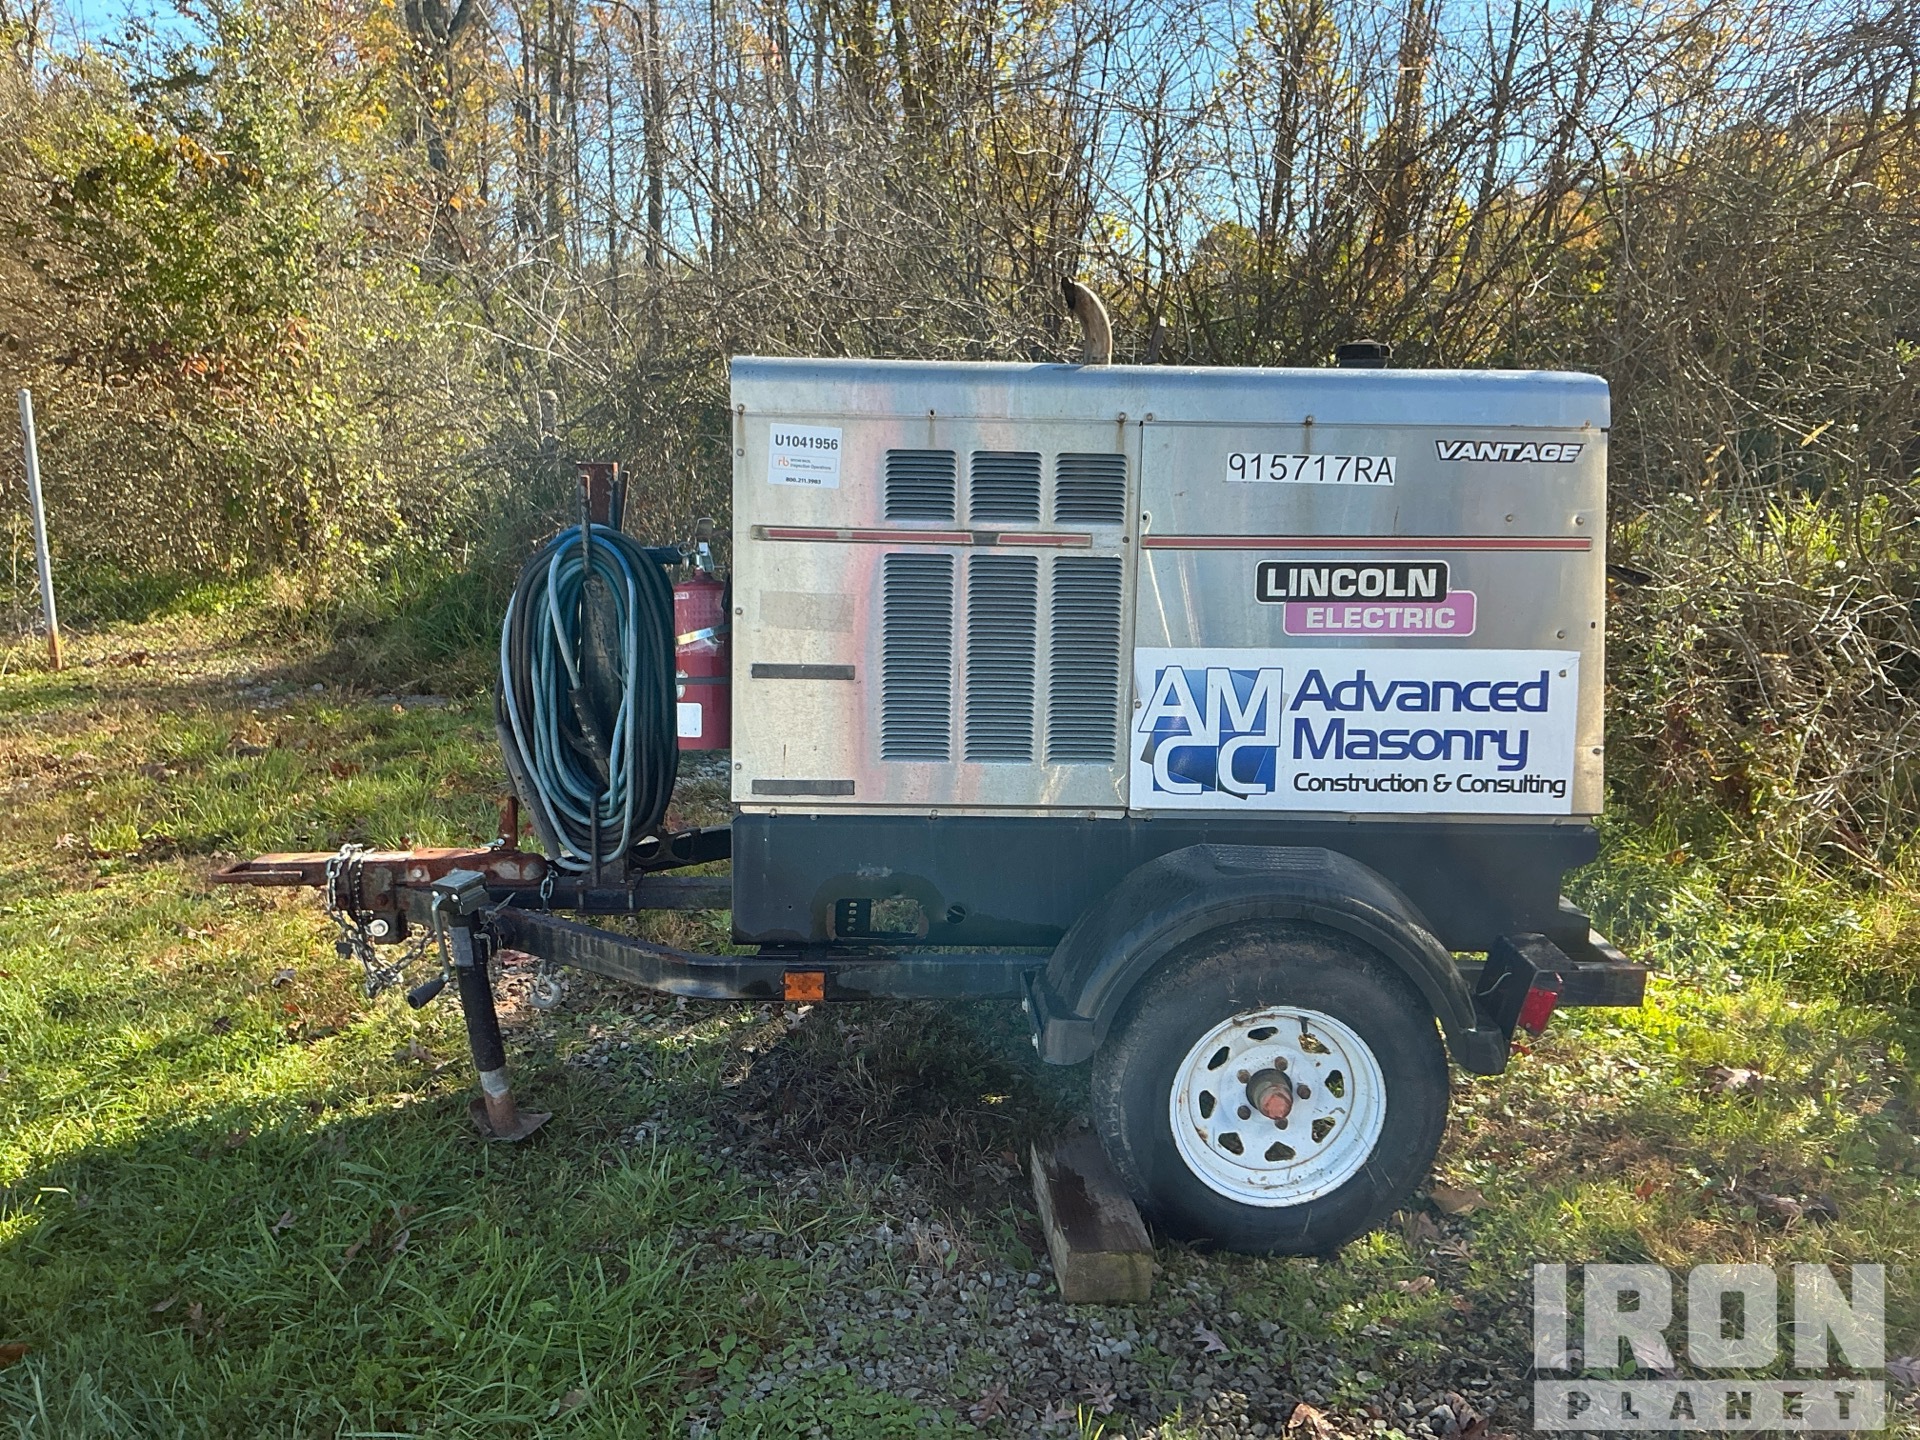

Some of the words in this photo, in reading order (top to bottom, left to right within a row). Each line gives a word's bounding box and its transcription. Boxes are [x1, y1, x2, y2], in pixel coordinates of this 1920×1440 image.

[775, 434, 838, 450] U1041956
[1435, 441, 1584, 463] VANTAGE
[1228, 453, 1394, 483] 915717RA
[1267, 568, 1437, 597] LINCOLN
[1306, 607, 1456, 629] ELECTRIC
[1290, 669, 1550, 712] Advanced
[1292, 717, 1529, 771] Masonry
[1293, 772, 1428, 793] Construction
[1433, 774, 1452, 792] &
[1456, 774, 1567, 798] Consulting
